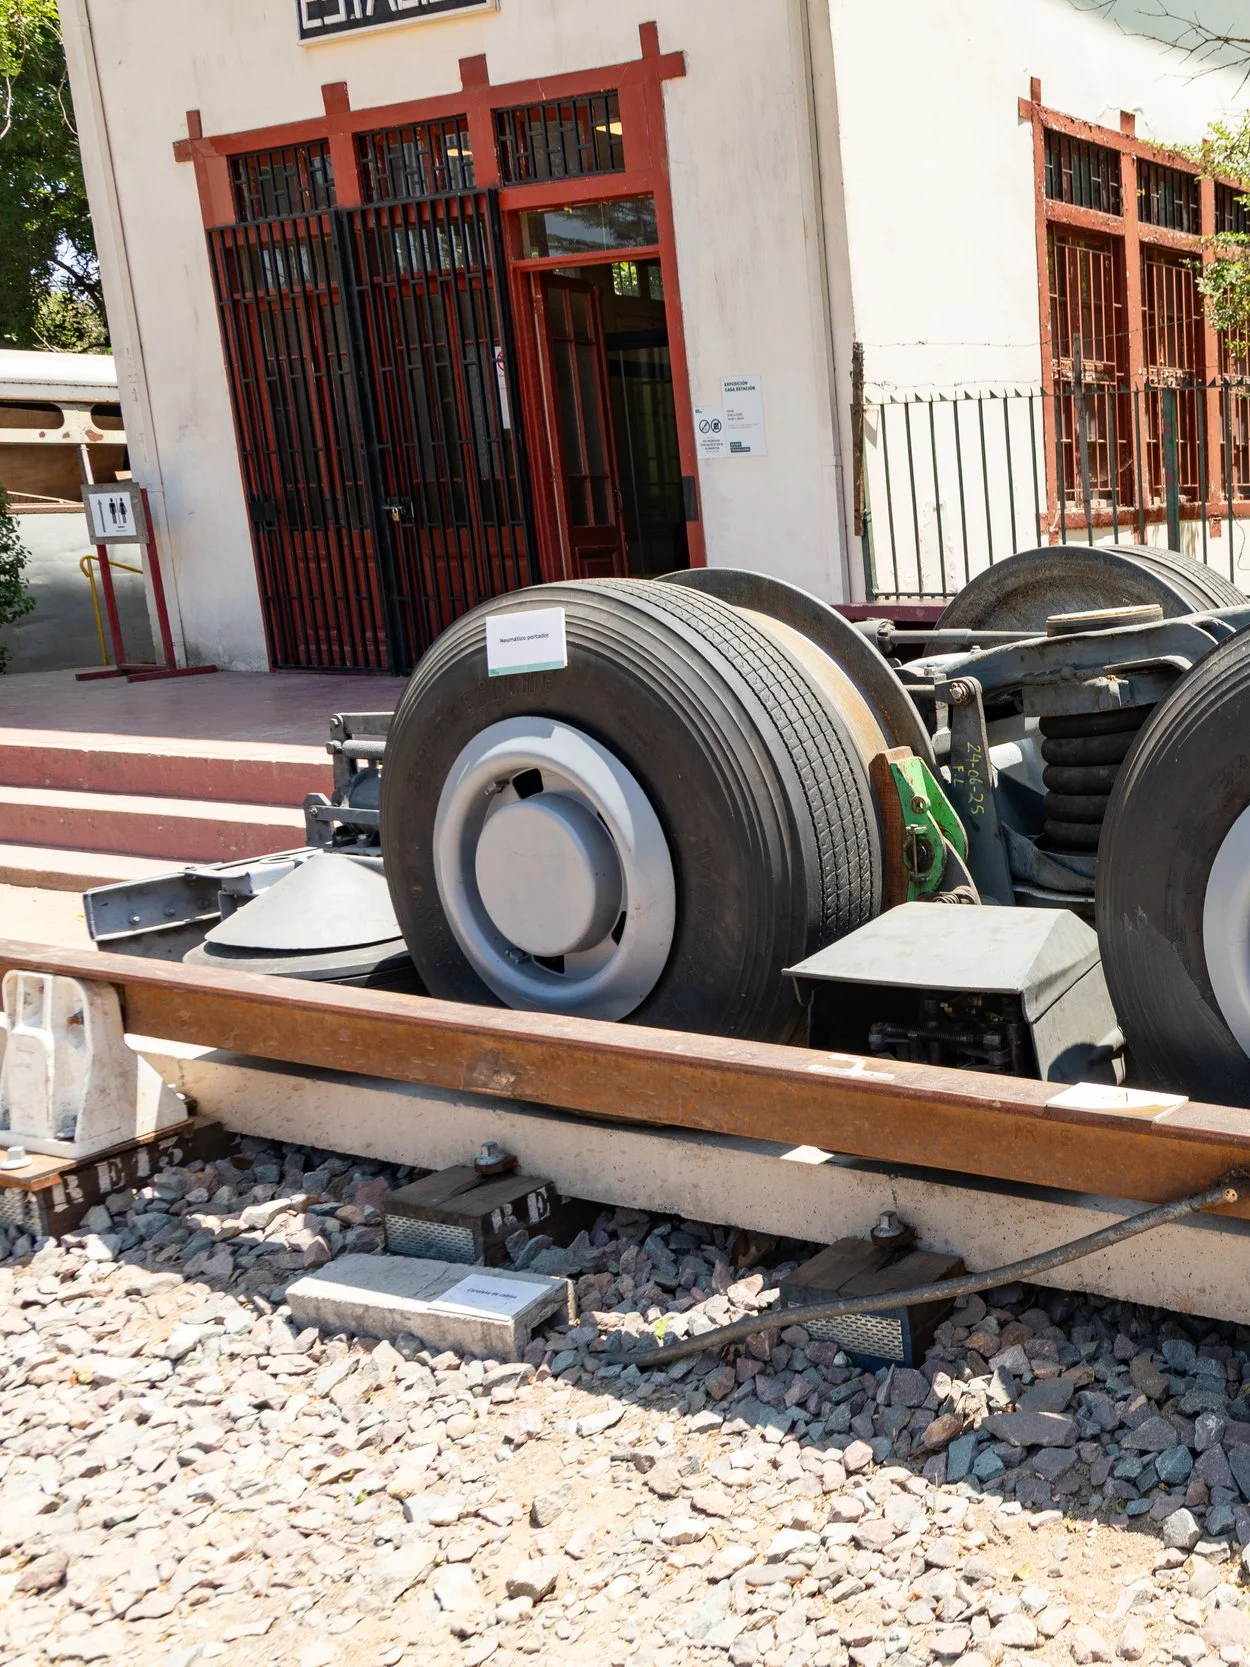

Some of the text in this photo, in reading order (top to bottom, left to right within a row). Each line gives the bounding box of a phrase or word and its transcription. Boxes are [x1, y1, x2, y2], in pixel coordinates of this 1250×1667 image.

[500, 632, 550, 643] Neumático portador
[965, 742, 985, 815] 24-06-25
